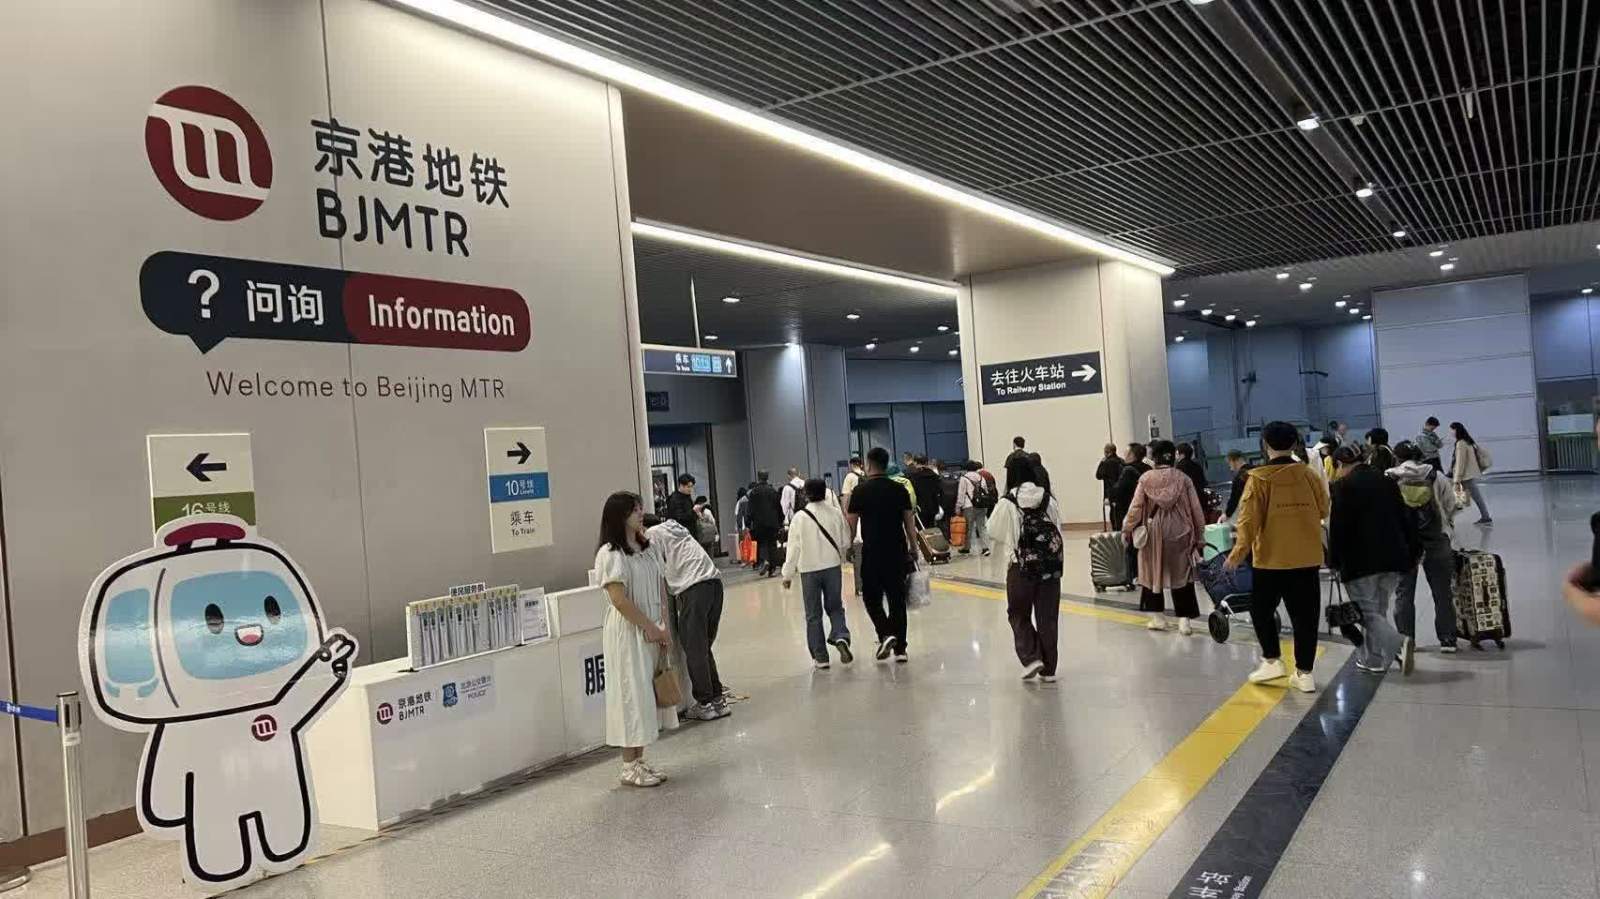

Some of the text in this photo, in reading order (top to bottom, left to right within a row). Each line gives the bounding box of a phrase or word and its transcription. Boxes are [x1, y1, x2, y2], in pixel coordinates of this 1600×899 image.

[311, 118, 509, 208] 京港地铁
[316, 189, 470, 256] BJMTR
[246, 280, 324, 325] 问询
[368, 295, 515, 336] Information
[206, 371, 504, 403] Welcome to Beijing MTR
[990, 363, 1065, 386] 去往火车站
[996, 381, 1066, 396] To Railway Station
[511, 511, 535, 526] 乘车
[398, 691, 432, 709] 京港地铁
[399, 705, 425, 720] BJMTR
